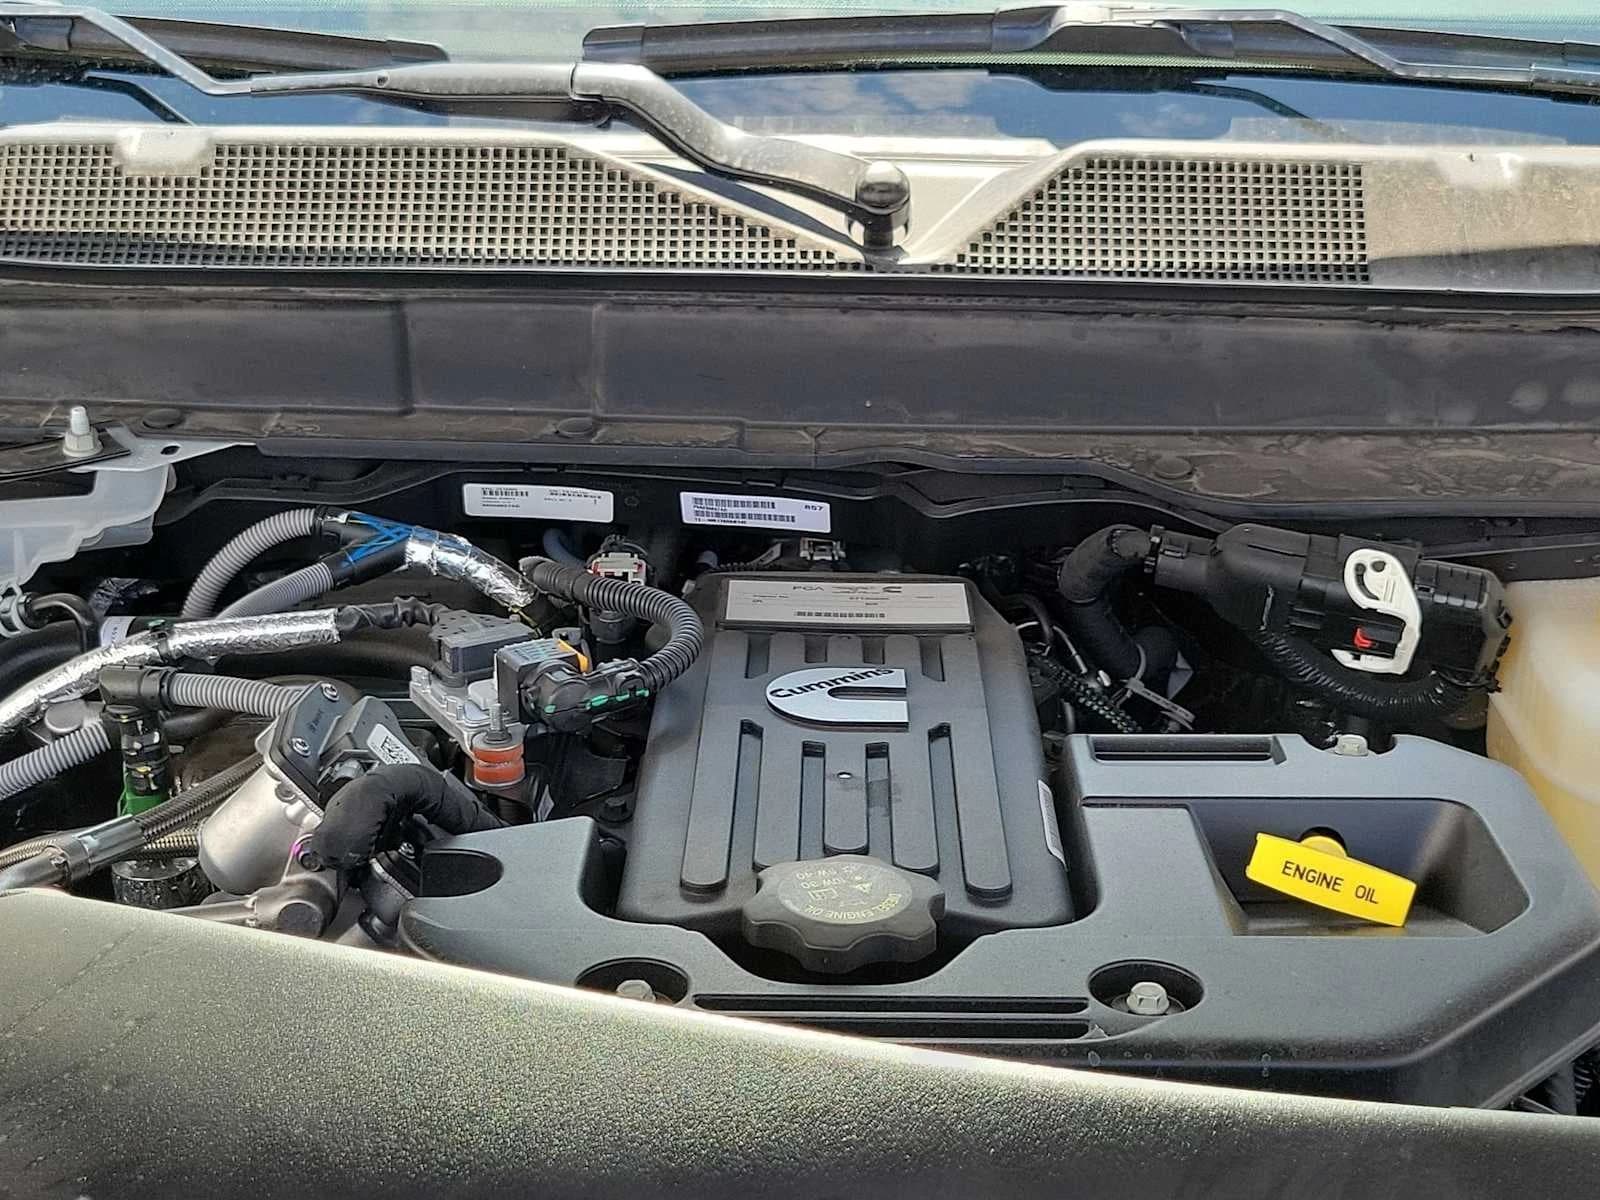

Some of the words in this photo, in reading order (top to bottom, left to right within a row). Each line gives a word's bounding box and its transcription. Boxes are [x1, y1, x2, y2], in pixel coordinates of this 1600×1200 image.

[768, 667, 895, 698] Cummins
[1281, 860, 1345, 893] ENGINE
[1355, 885, 1380, 904] OIL
